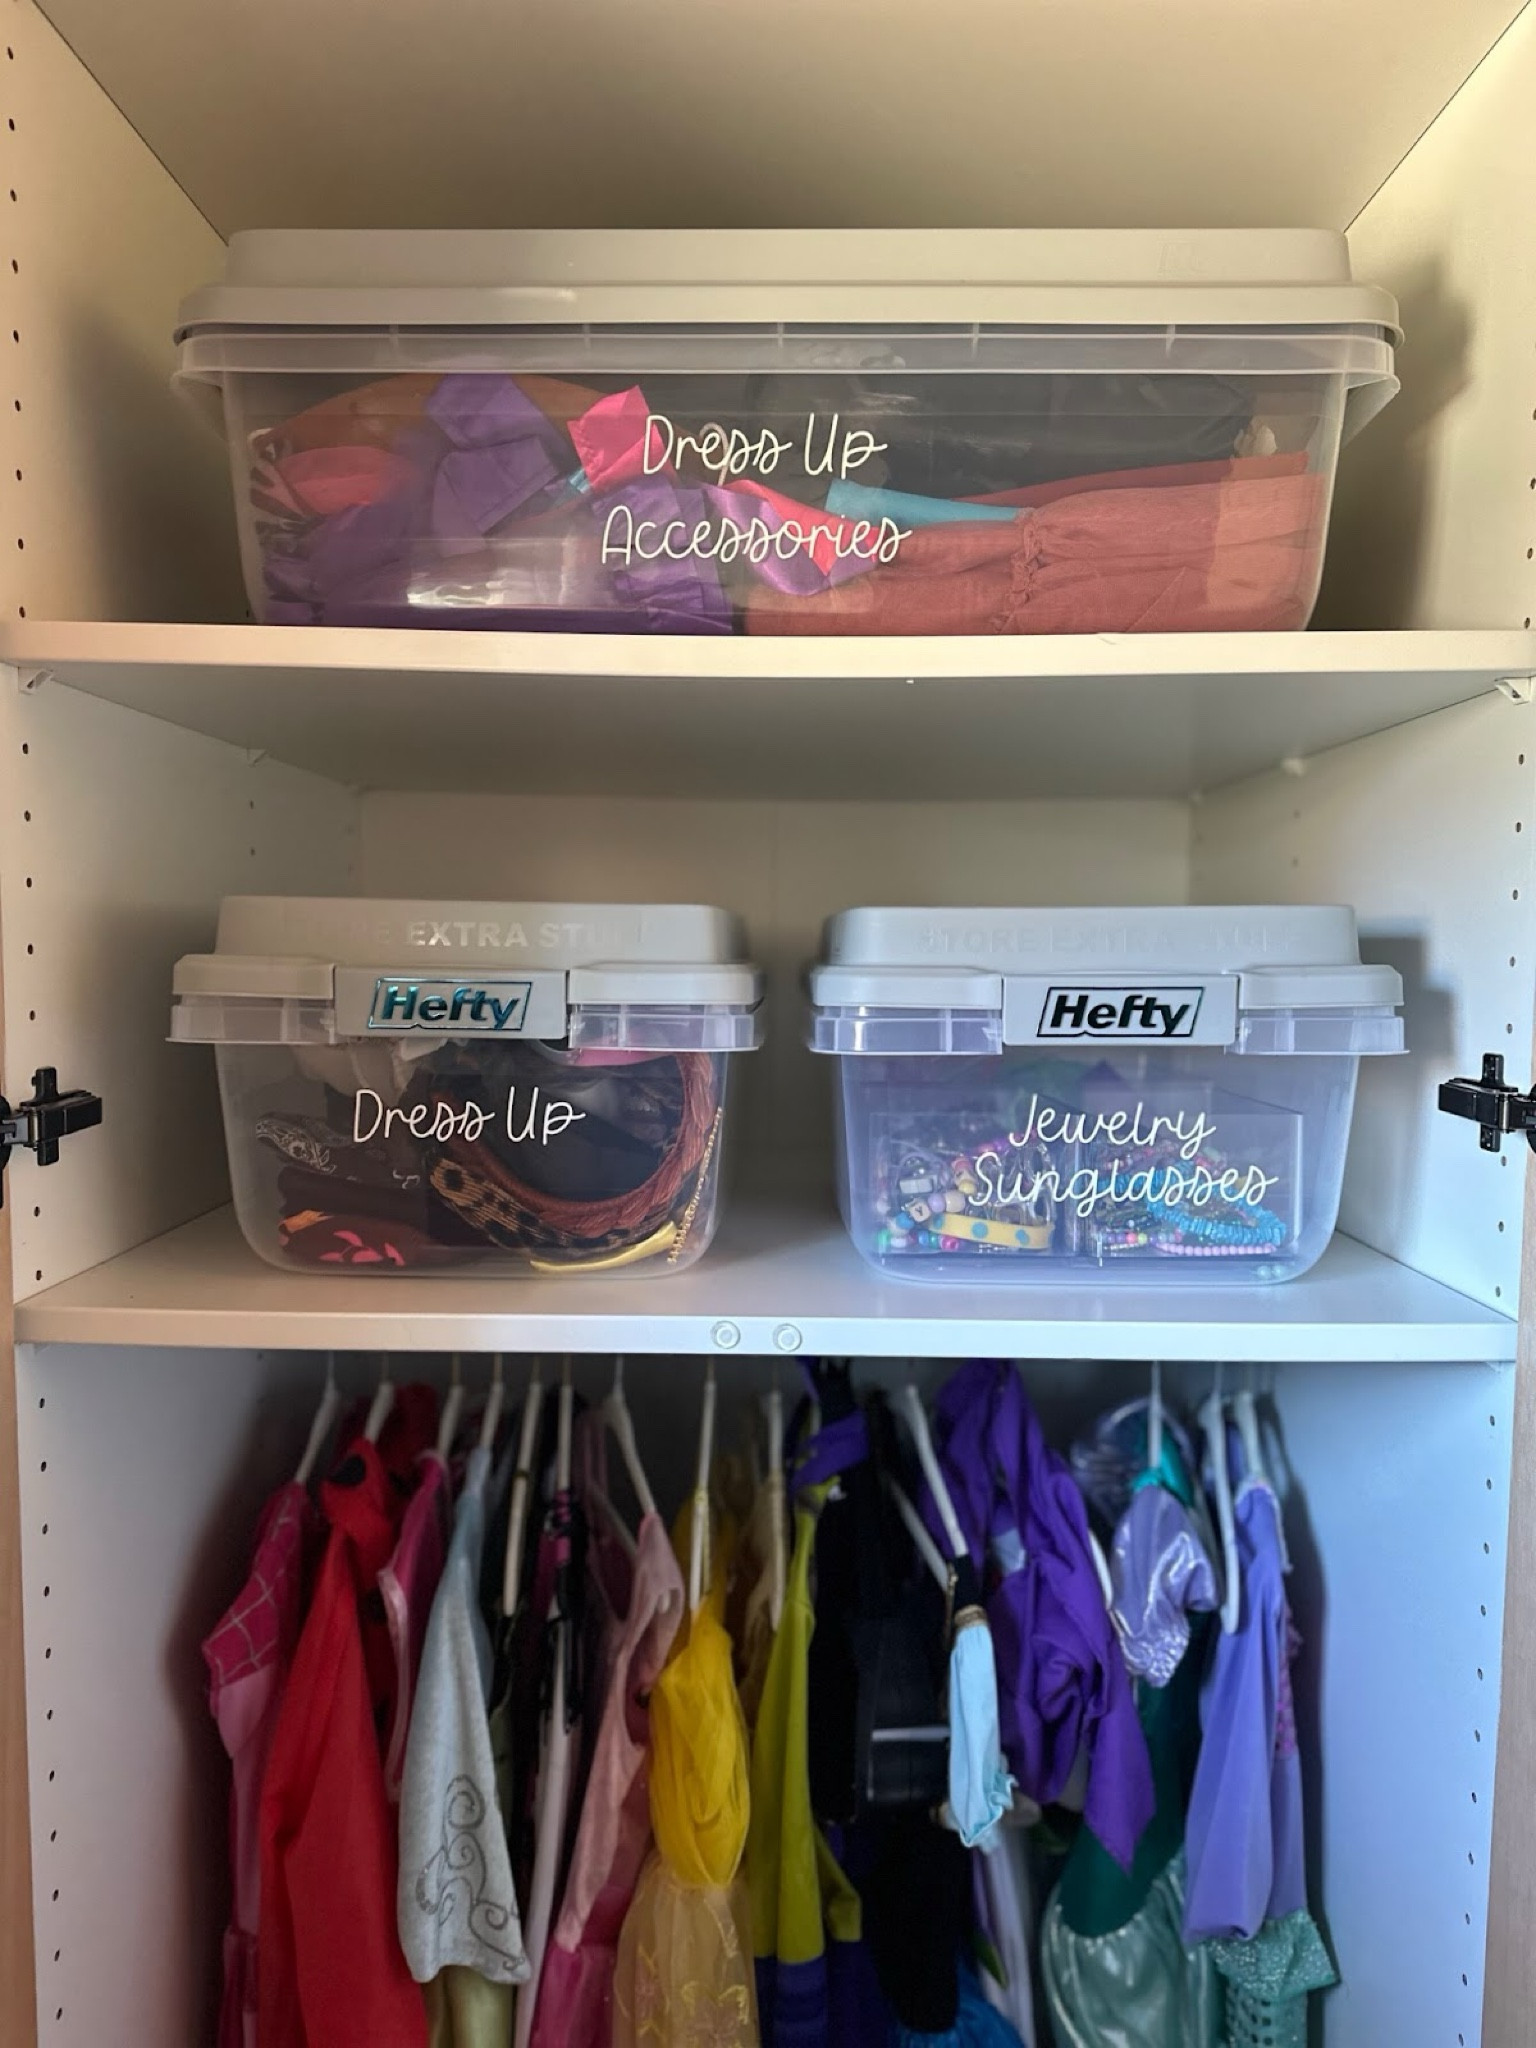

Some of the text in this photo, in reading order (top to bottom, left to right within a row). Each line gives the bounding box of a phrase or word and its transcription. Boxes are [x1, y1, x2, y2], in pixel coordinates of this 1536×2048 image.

[643, 412, 888, 480] Dress Up
[602, 505, 913, 565] Accessories
[409, 921, 529, 948] EXTRA
[380, 985, 521, 1030] Hefty
[1049, 993, 1191, 1037] Hefty
[353, 1086, 587, 1147] Dress Up
[1009, 1093, 1217, 1160] Jewelry
[968, 1151, 1280, 1217] Sunglasses
